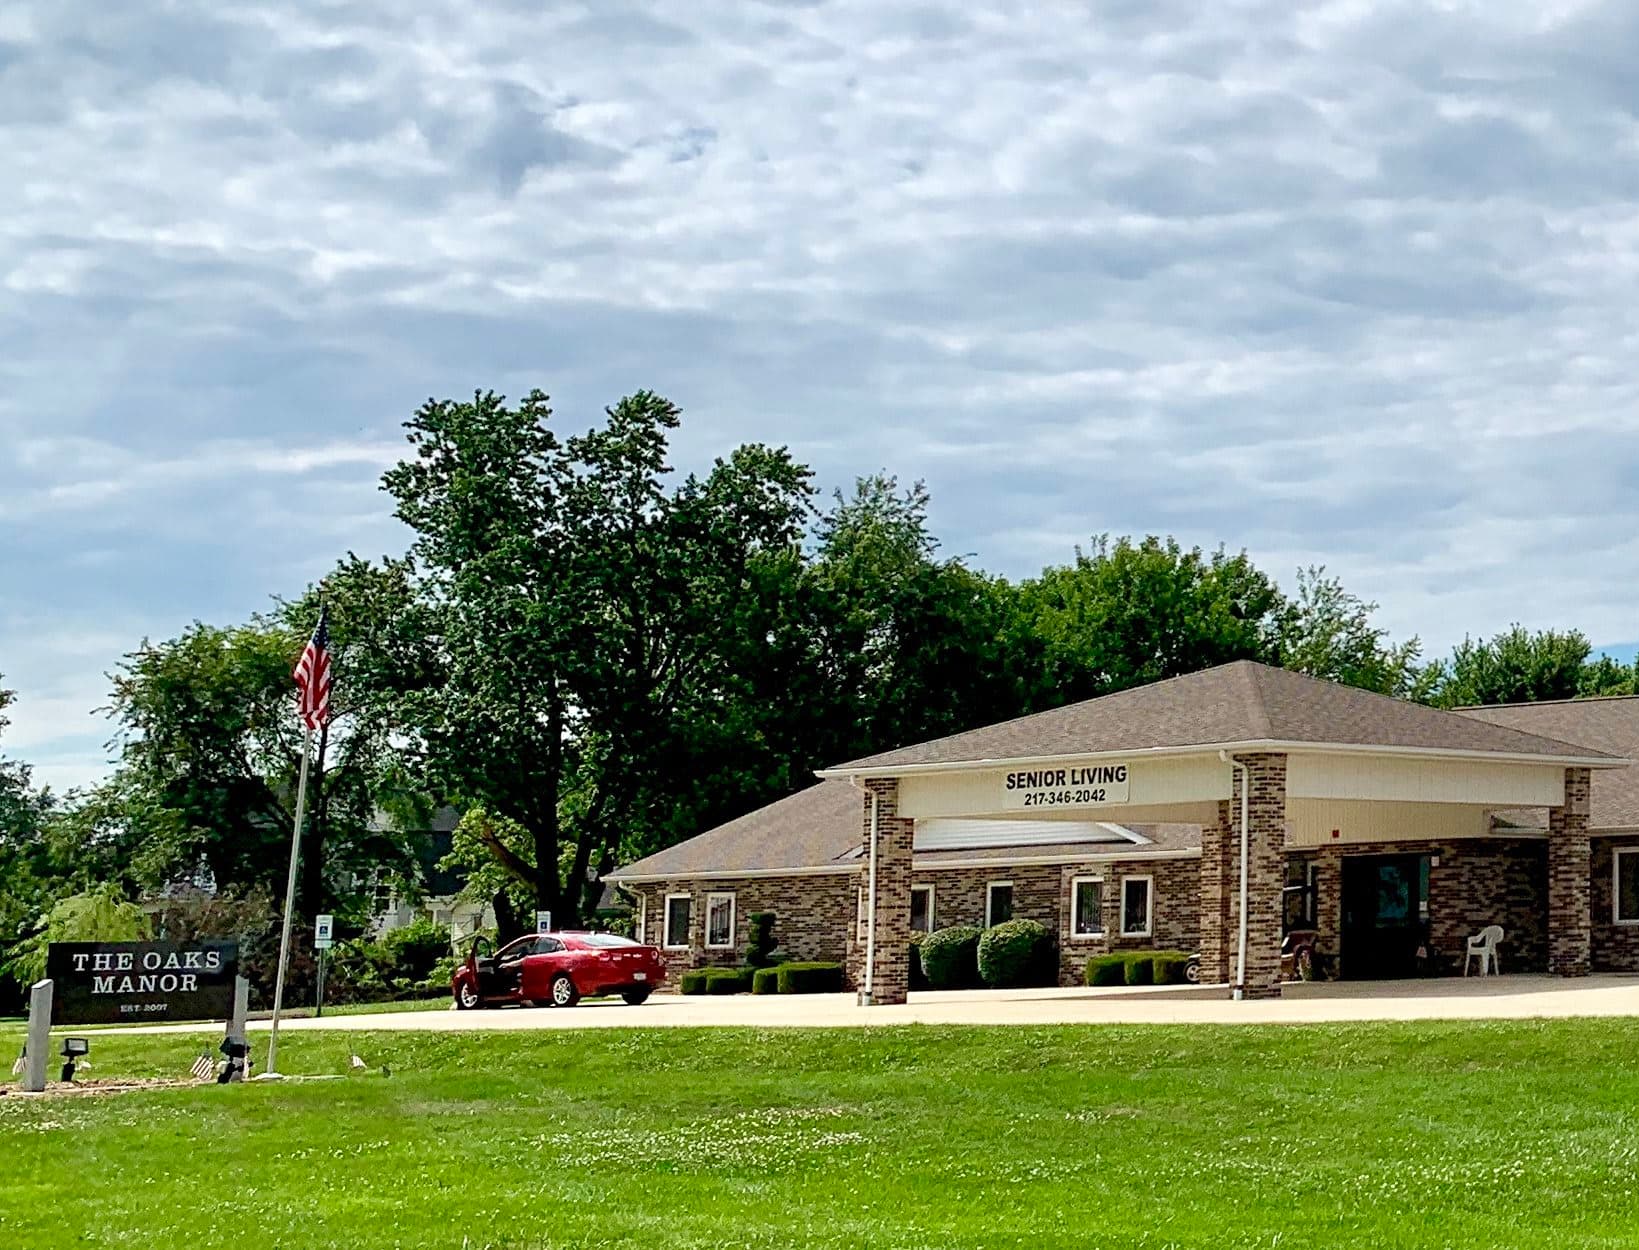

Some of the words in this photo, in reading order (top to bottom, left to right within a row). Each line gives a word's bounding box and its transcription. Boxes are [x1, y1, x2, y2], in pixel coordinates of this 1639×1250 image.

[1006, 770, 1066, 790] SENIOR
[1071, 765, 1127, 785] LIVING
[1024, 788, 1106, 806] 217-346-2042
[73, 953, 134, 972] THE
[143, 951, 220, 971] OAKS
[91, 974, 198, 994] MANOR
